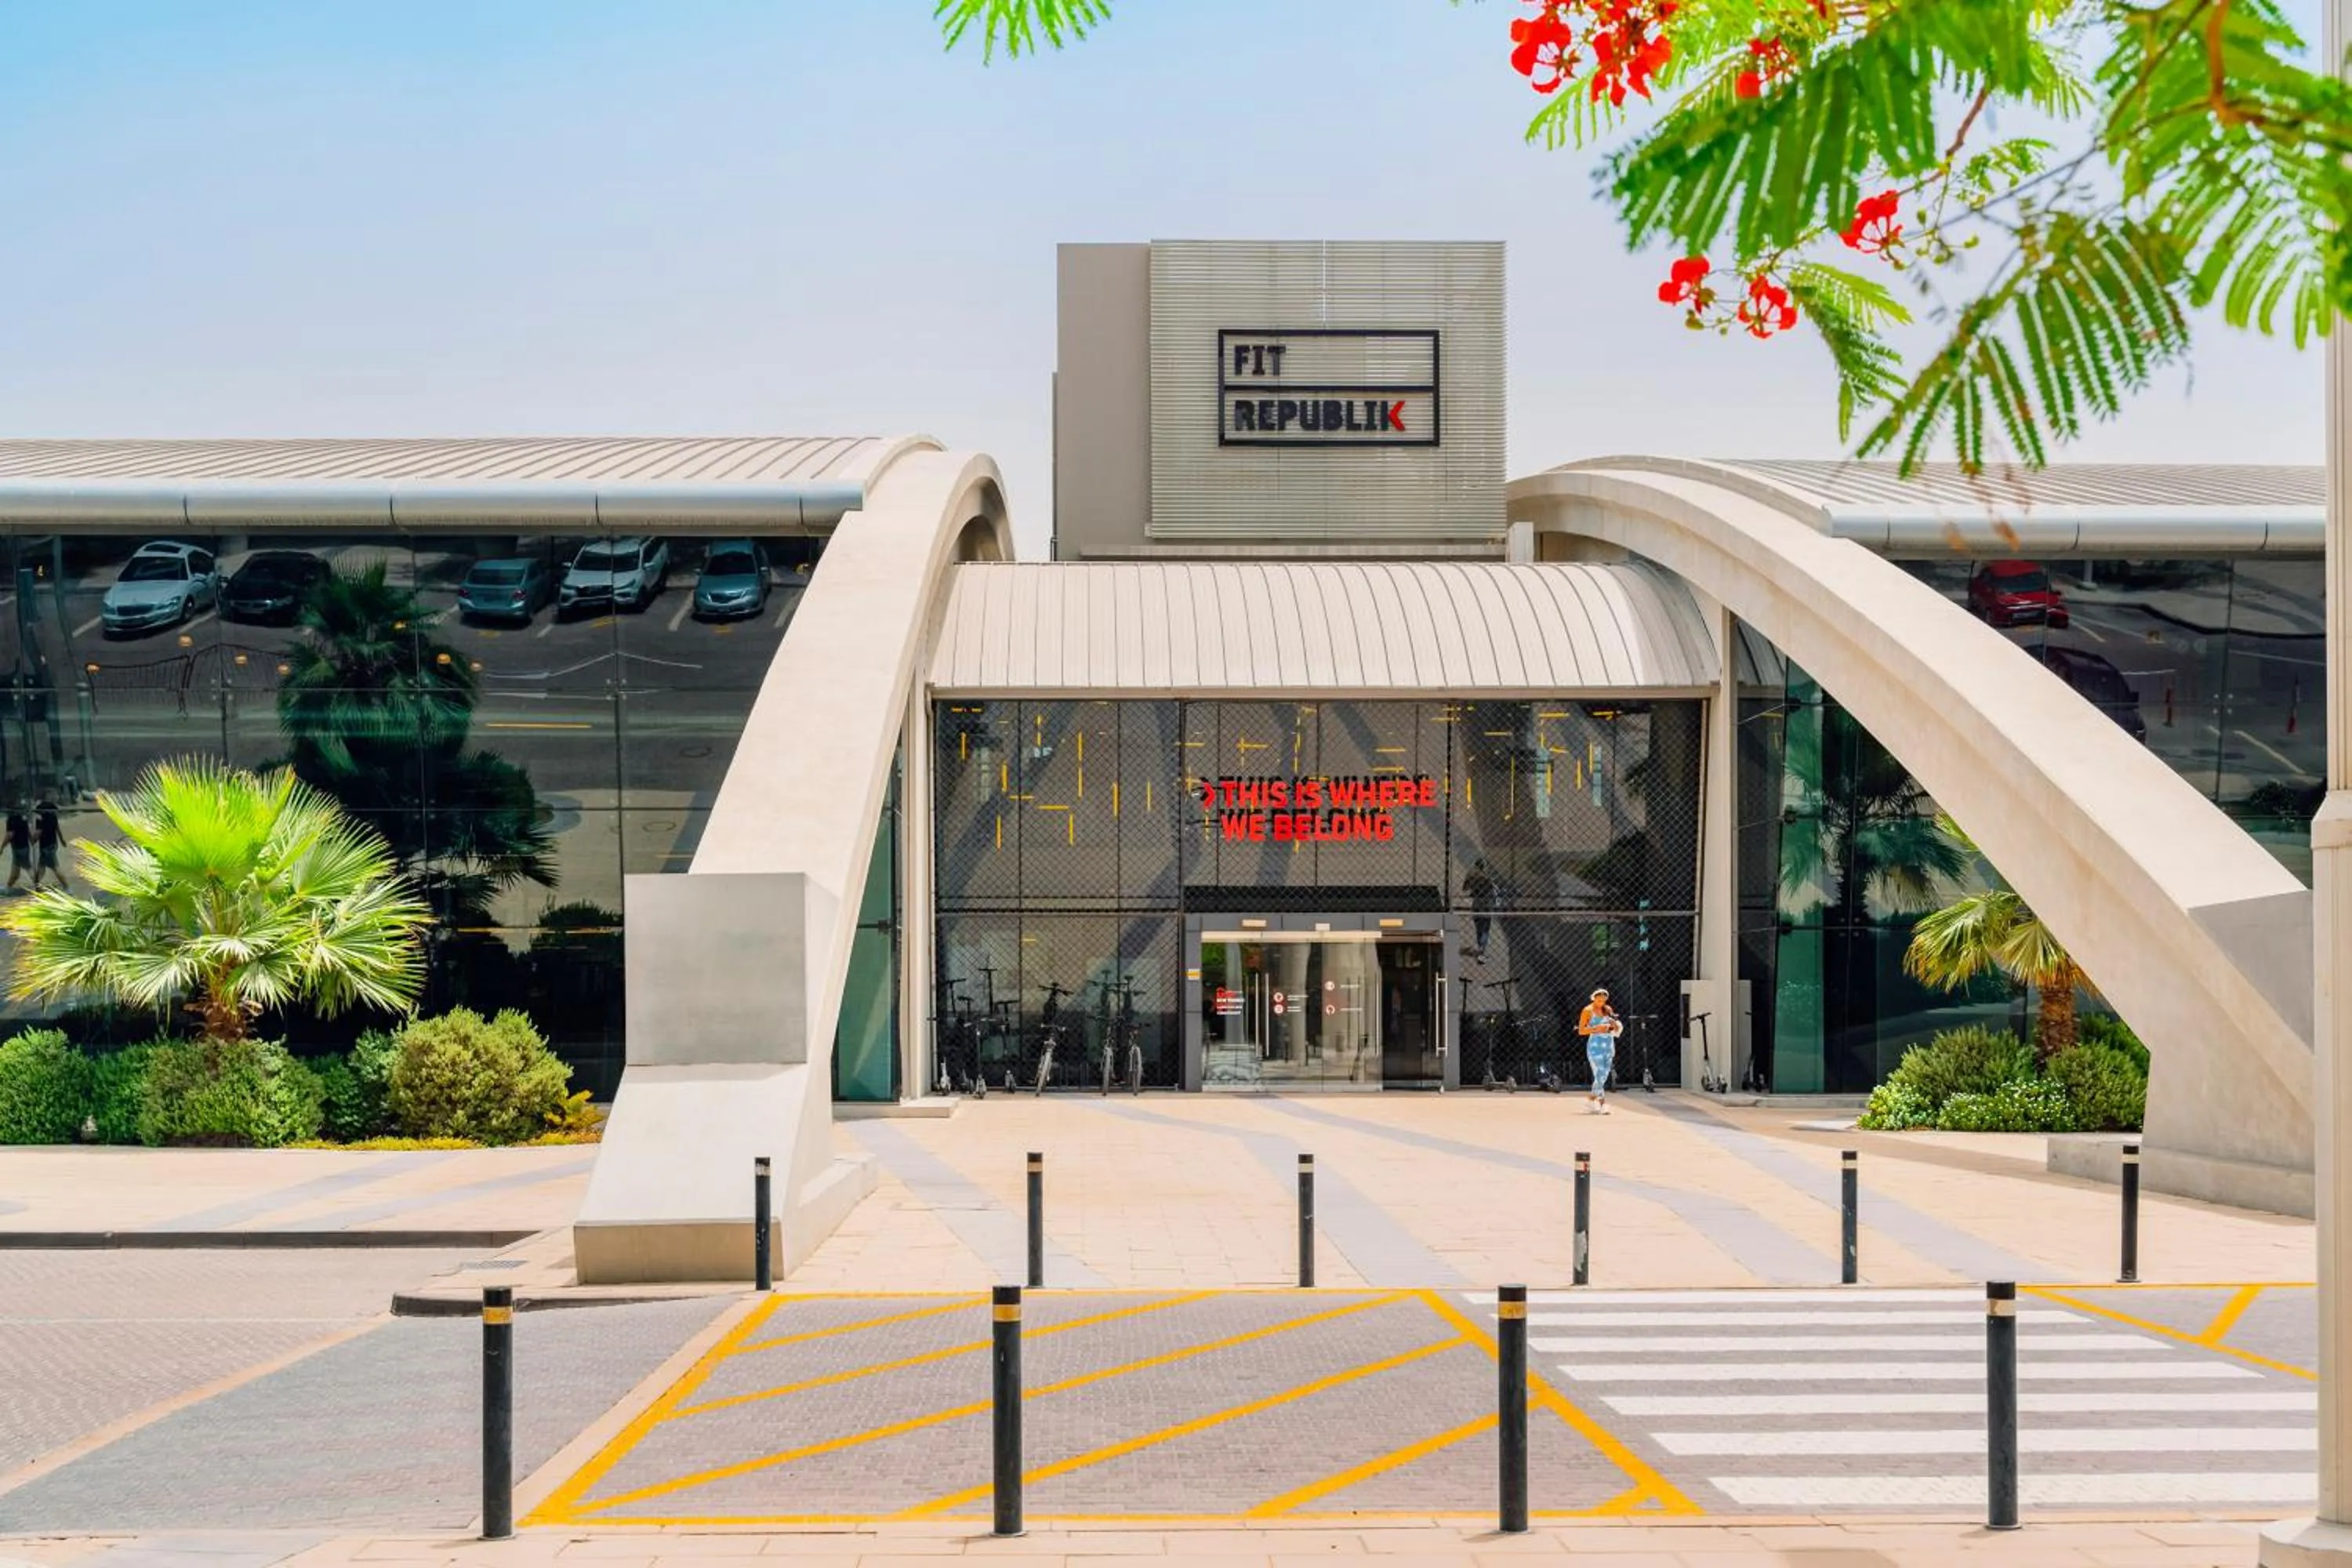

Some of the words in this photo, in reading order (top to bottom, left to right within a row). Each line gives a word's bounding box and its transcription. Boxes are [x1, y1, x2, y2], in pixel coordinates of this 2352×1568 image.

[1233, 344, 1286, 376] FIT
[1234, 400, 1406, 432] REPUBLIK
[1221, 781, 1288, 808] THIS
[1295, 781, 1323, 808] IS
[1329, 781, 1438, 808] WHERE
[1221, 815, 1266, 841] WE
[1272, 815, 1395, 841] BELONG
